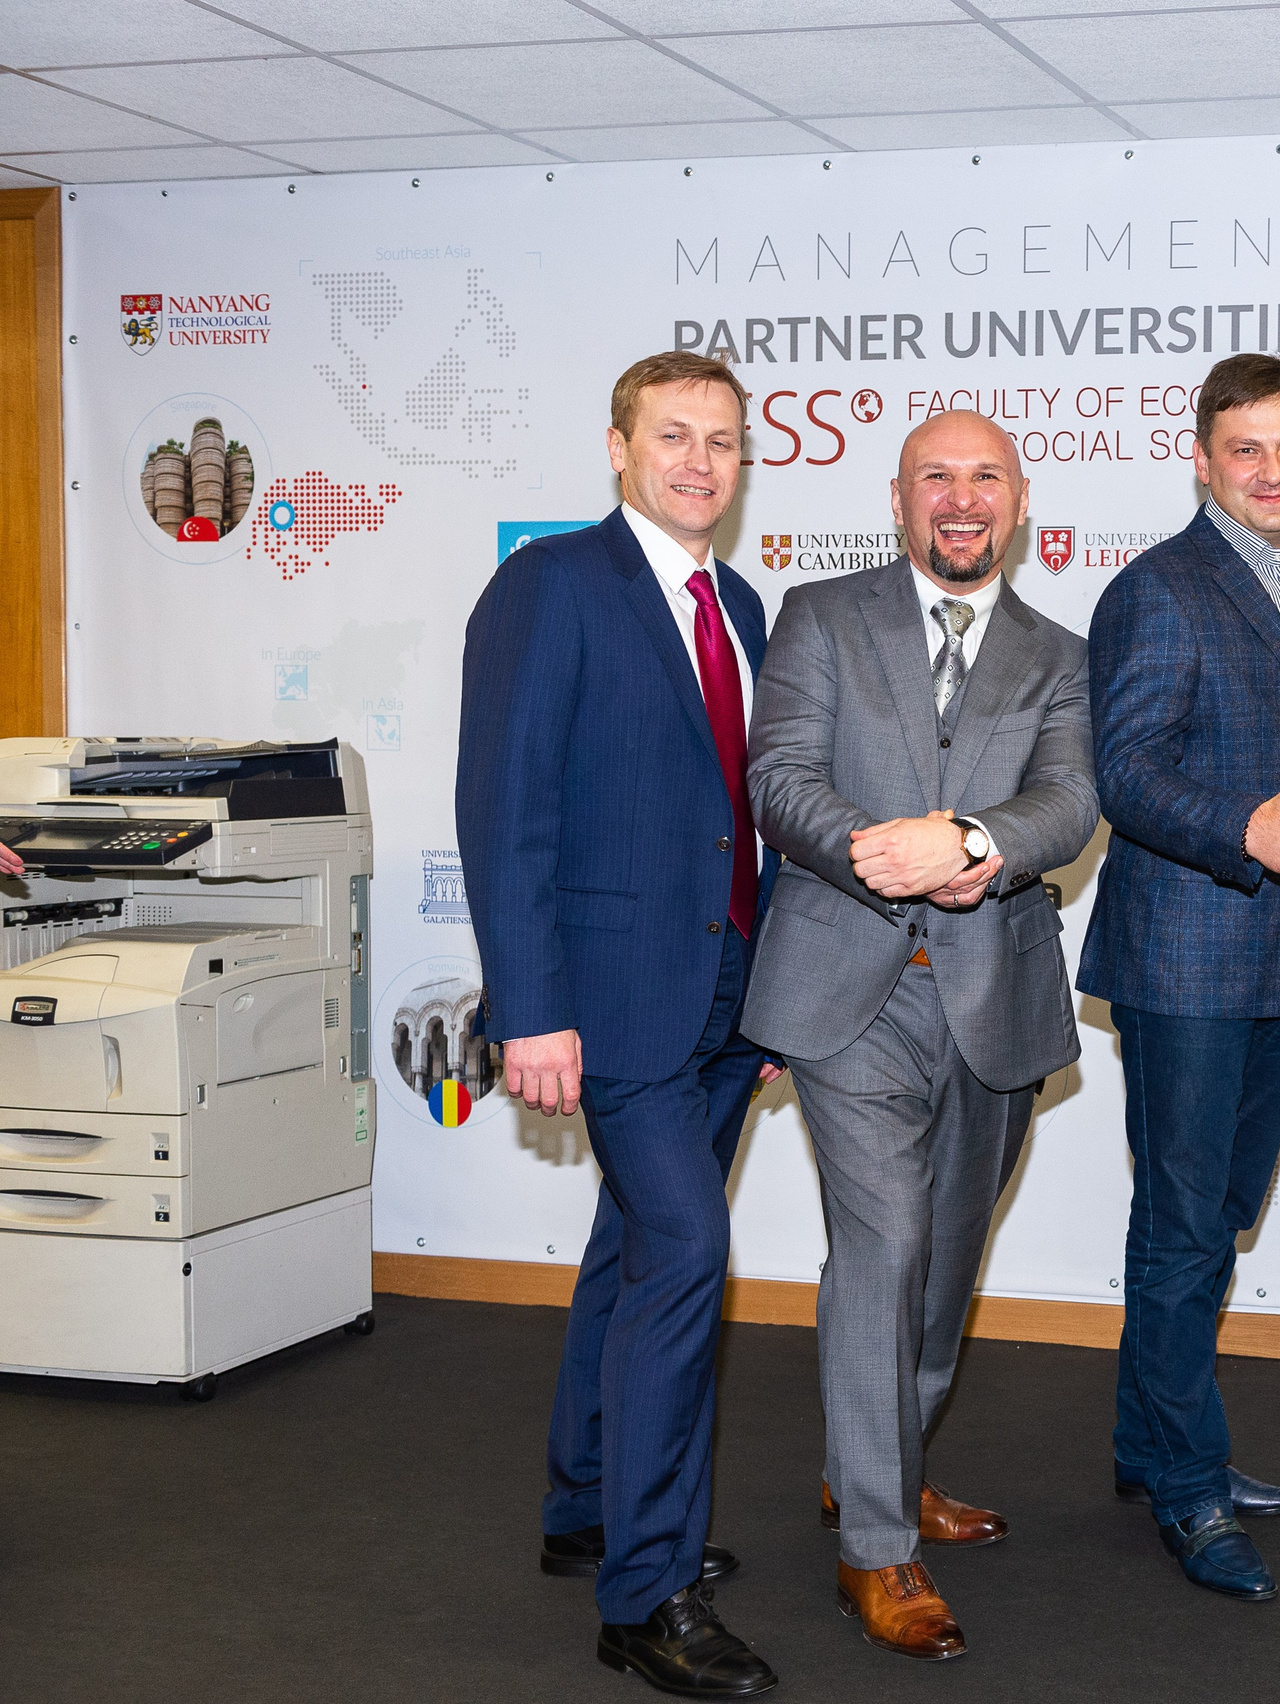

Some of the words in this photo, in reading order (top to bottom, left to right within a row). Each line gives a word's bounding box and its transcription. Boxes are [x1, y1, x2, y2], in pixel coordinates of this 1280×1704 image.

[376, 246, 440, 261] Southeast
[444, 244, 471, 259] Asia
[168, 293, 271, 314] NANYANG
[168, 315, 272, 328] TECHNOLOGICAL
[169, 329, 271, 346] UNIVERSITY
[674, 313, 927, 364] PARTNER
[908, 387, 1061, 421] FACULTY
[1075, 386, 1125, 418] OF
[1007, 430, 1134, 462] OCIAL
[797, 533, 905, 548] UNIVERSITY
[797, 551, 900, 571] CAMBRID
[261, 647, 273, 661] In
[277, 646, 322, 663] Europe
[362, 698, 374, 711] In
[377, 697, 404, 711] Asia
[421, 849, 461, 859] UNIVERS
[423, 915, 472, 925] GALATIENSI
[427, 963, 470, 975] Romania
[158, 1152, 163, 1160] 1
[158, 1213, 165, 1221] 2
